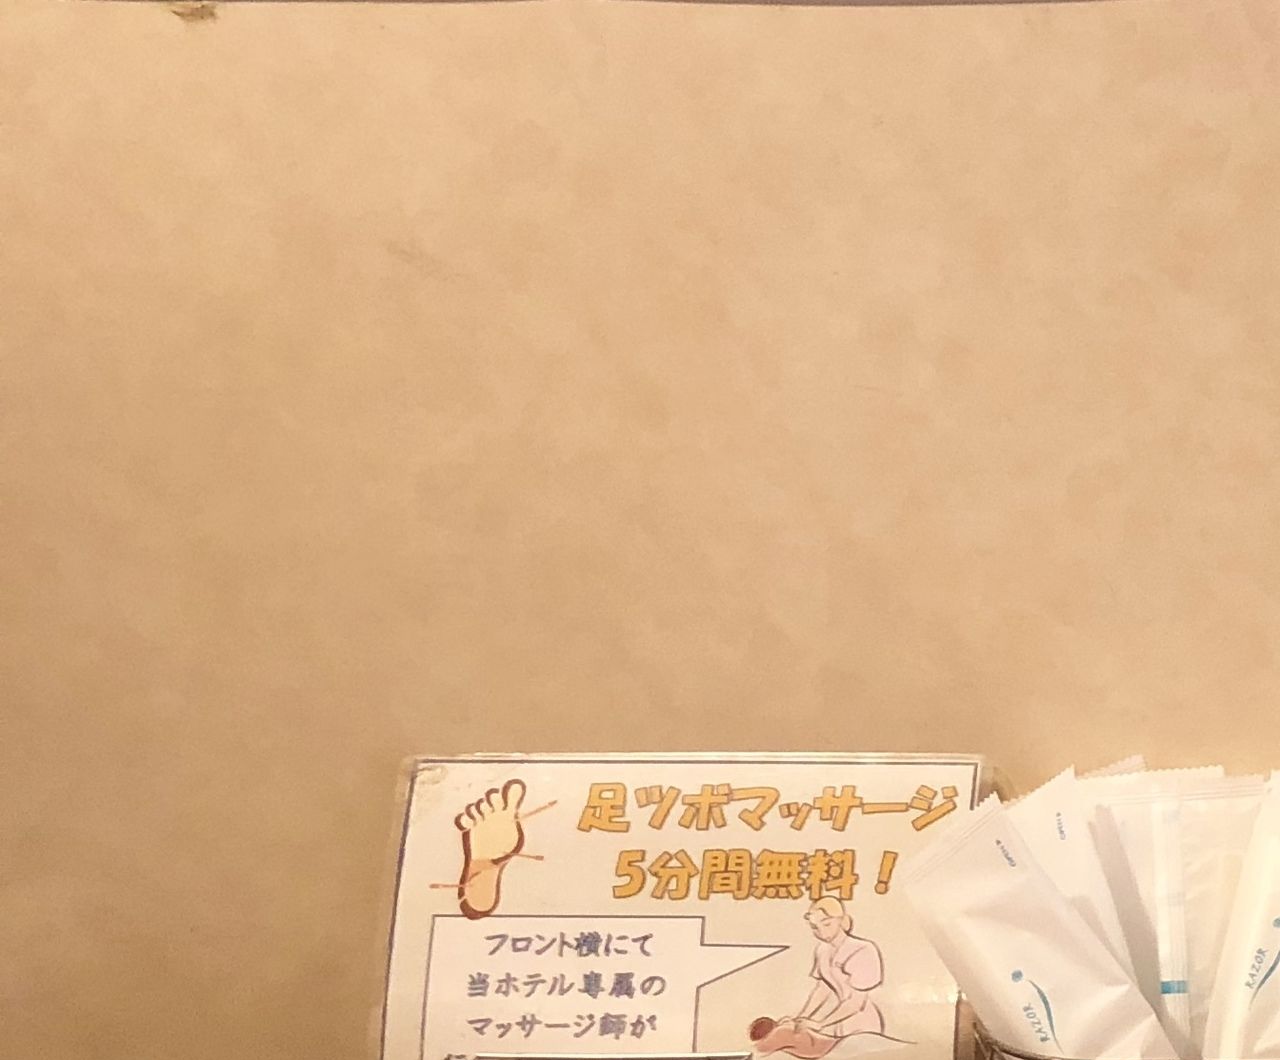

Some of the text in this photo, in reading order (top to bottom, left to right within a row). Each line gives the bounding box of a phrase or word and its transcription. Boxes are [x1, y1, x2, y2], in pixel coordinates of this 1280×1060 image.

[577, 782, 958, 834] 足ツボマッサージ
[485, 930, 653, 958] フロント横にて
[465, 970, 667, 998] 当ホテル専属の
[1244, 947, 1269, 991] RAZOR
[465, 1012, 658, 1040] マッサージ師が
[1022, 1001, 1050, 1043] RAZOR
